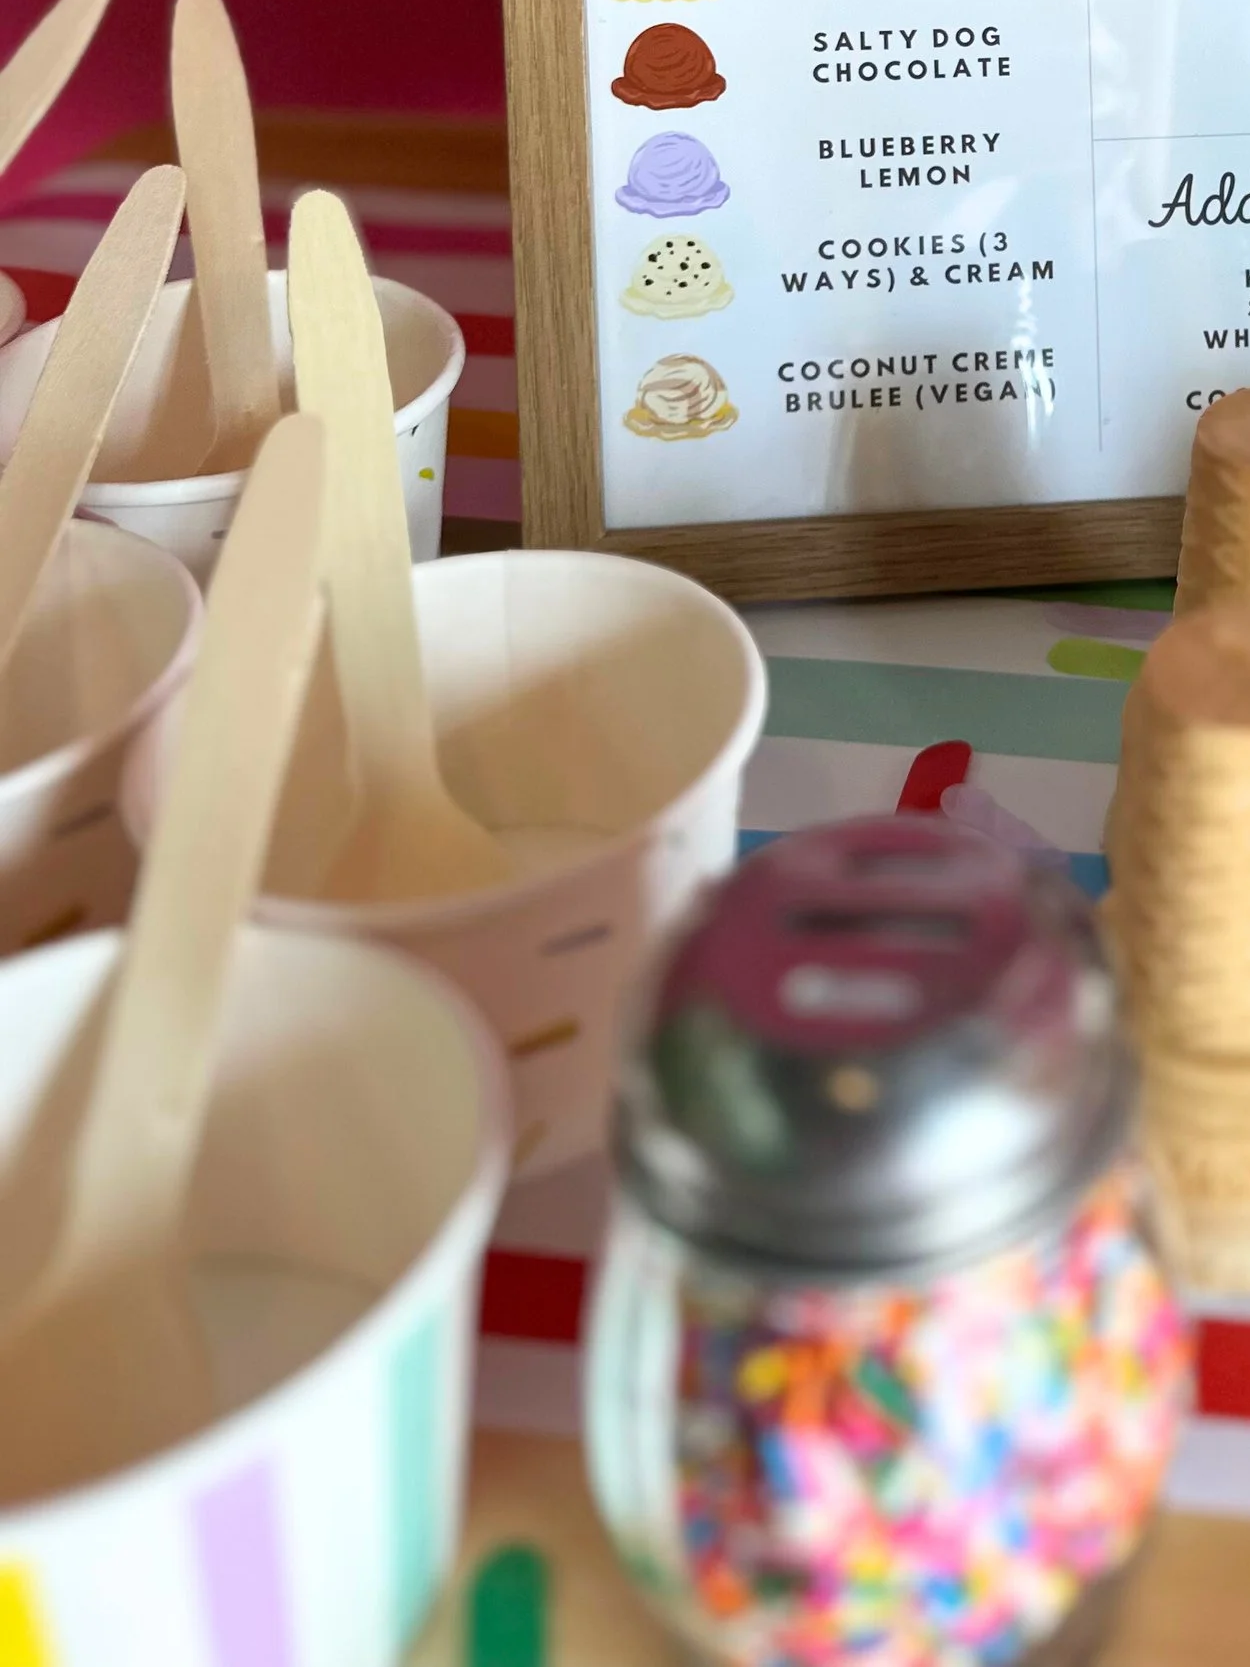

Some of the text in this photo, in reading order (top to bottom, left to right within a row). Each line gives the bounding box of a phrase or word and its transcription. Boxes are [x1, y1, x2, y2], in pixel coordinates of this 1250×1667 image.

[813, 26, 1001, 53] SALTY DOG
[812, 56, 1011, 84] CHOCOLATE
[818, 132, 1001, 160] BLUEBERRY
[860, 164, 971, 189] LEMON
[817, 231, 1009, 261] COOKIES (3
[780, 259, 1055, 294] WAYS) & CREAM
[777, 347, 1055, 383] COCONUT CREME
[785, 386, 902, 414] BRULEE
